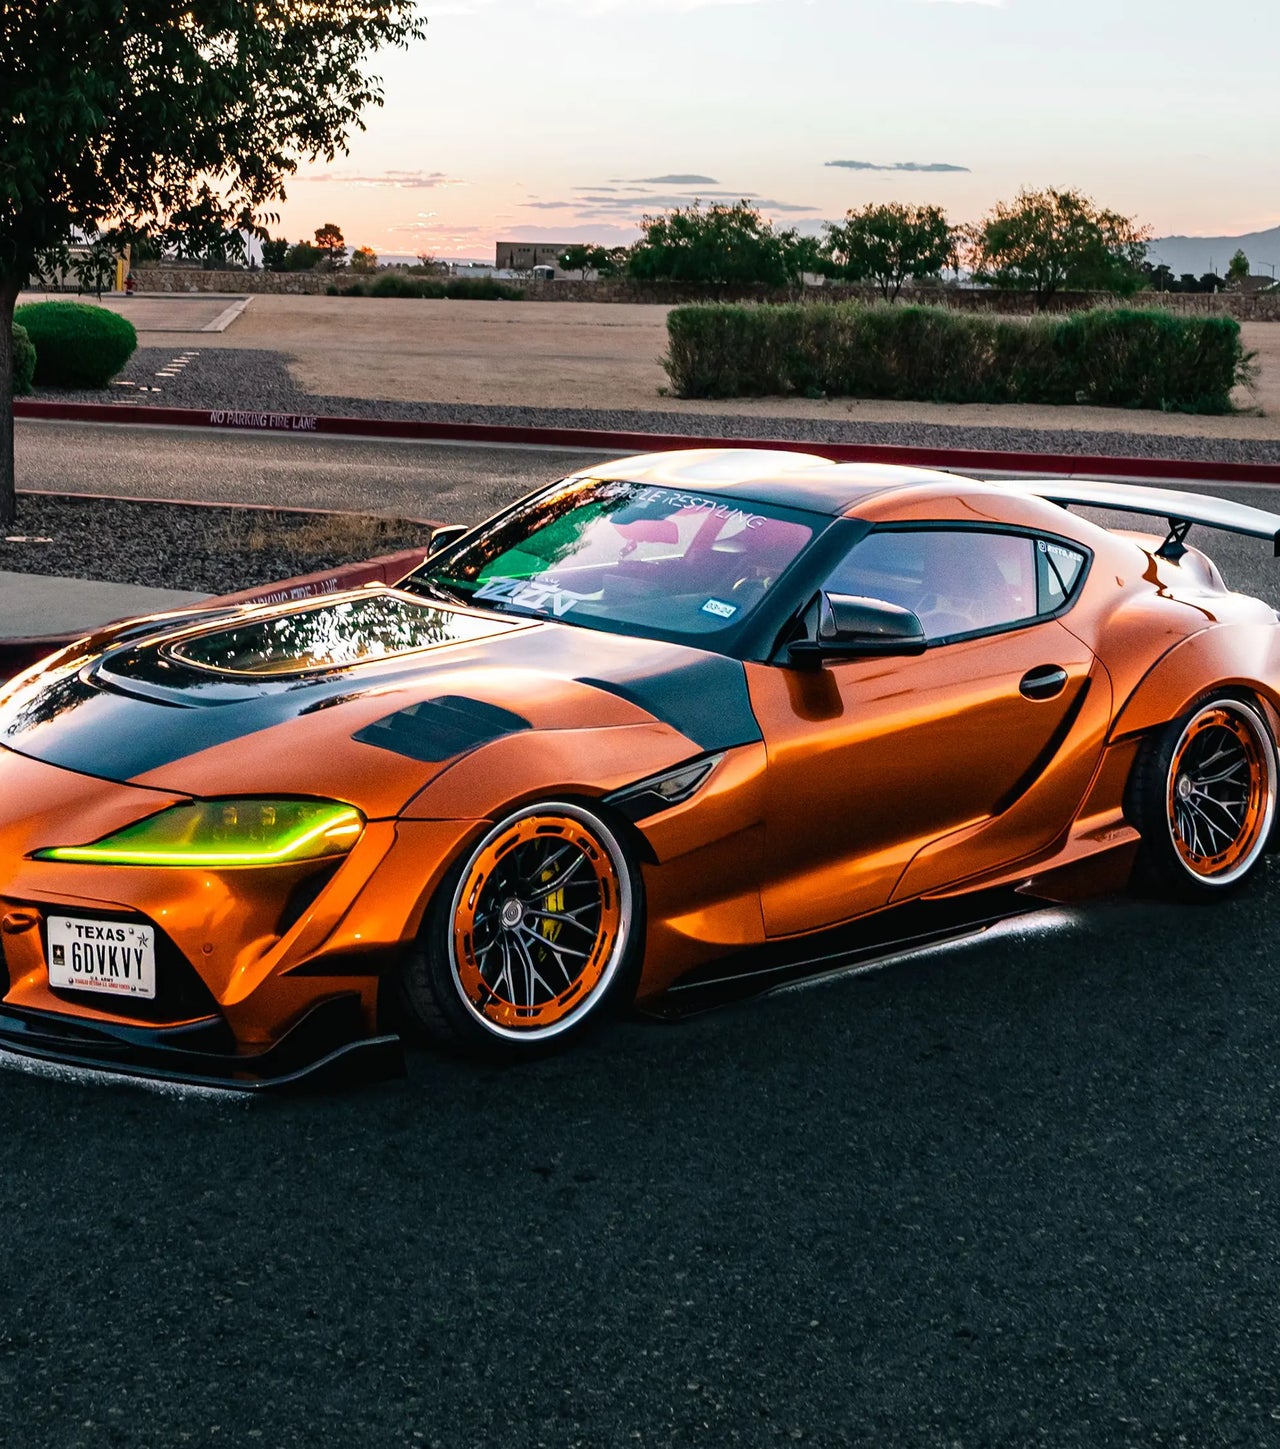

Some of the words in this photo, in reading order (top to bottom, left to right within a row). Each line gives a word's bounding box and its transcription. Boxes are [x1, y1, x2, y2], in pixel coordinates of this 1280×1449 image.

[210, 411, 225, 424] NO
[226, 411, 267, 427] PARKING
[269, 415, 290, 429] FIRE
[292, 416, 317, 430] LANE
[662, 492, 768, 530] RESTYLING
[75, 924, 126, 942] TEXAS
[72, 941, 143, 980] 6DVKVY
